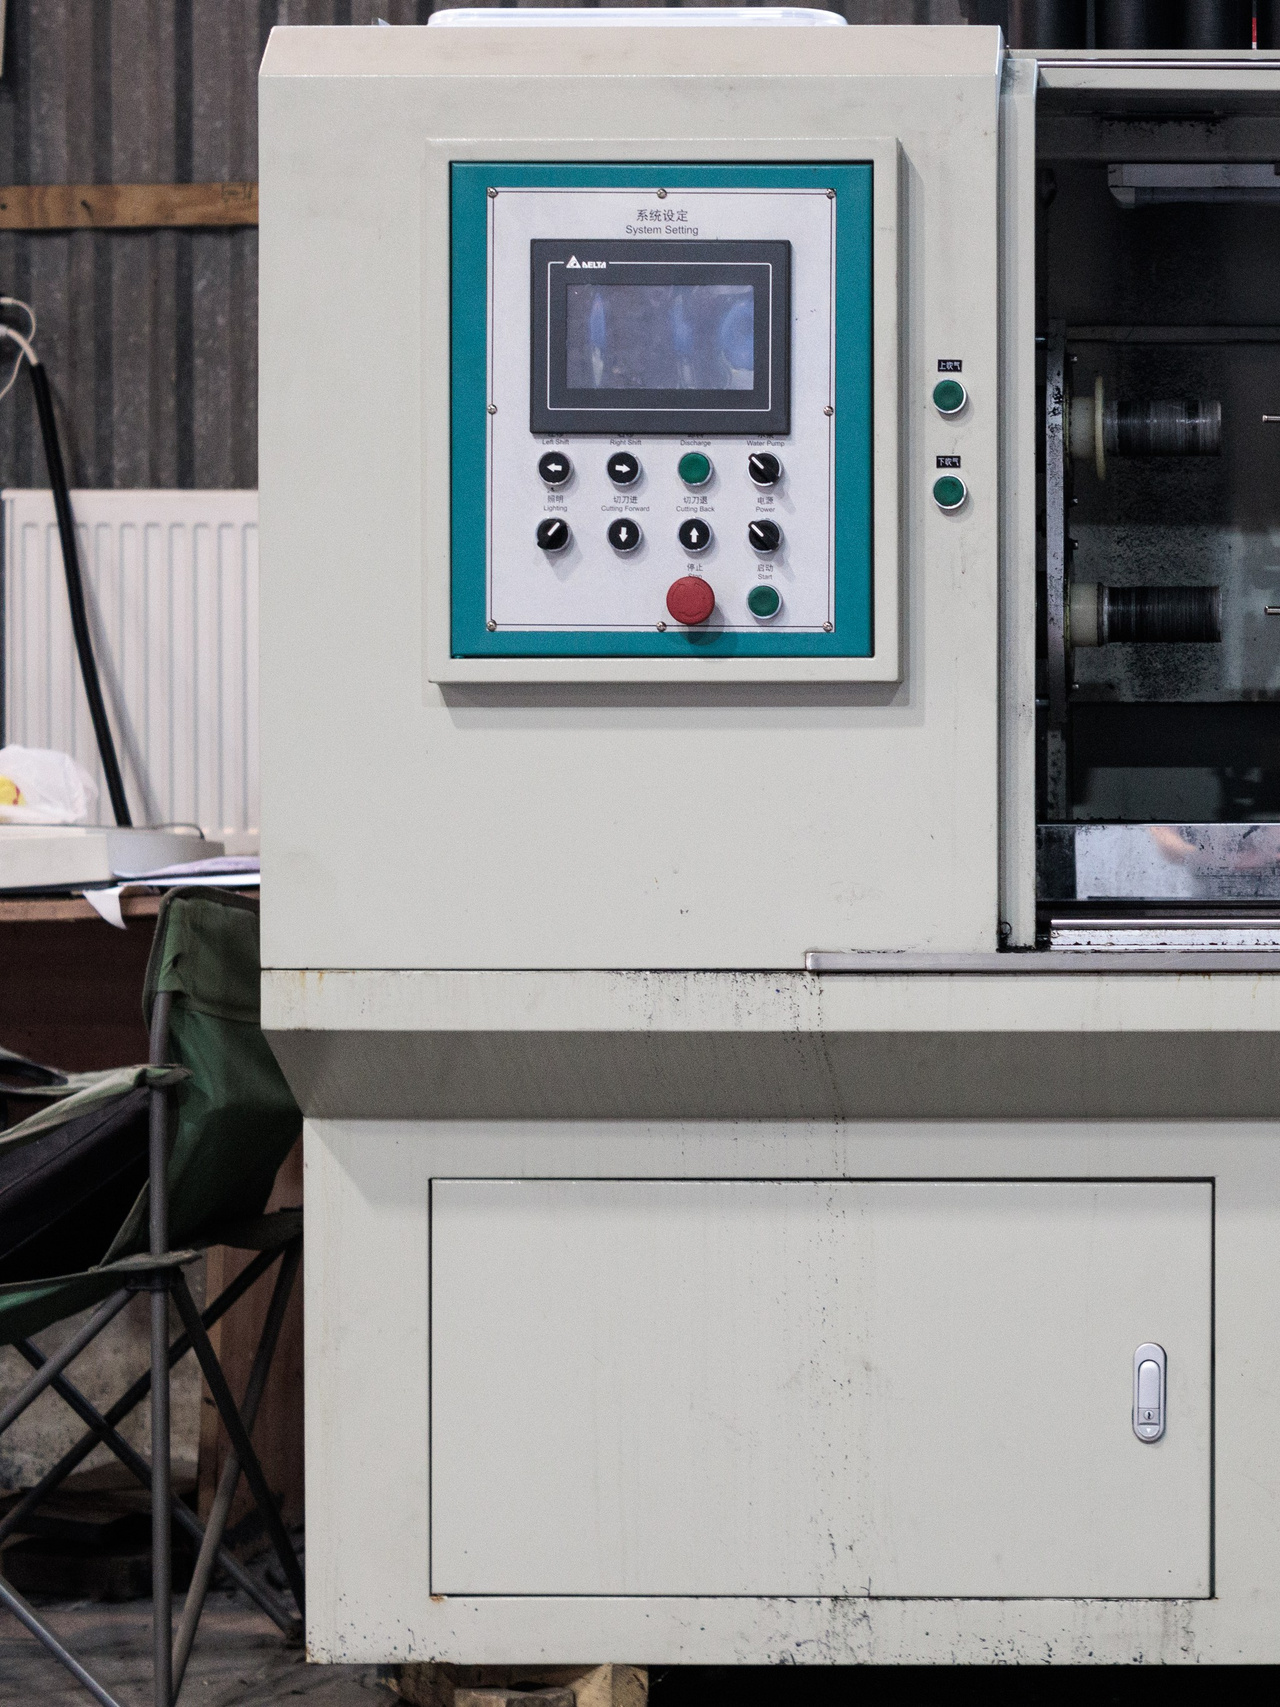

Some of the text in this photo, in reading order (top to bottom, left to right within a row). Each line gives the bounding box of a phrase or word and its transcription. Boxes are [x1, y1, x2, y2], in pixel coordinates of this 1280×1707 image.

[636, 209, 688, 222] 系统设定
[625, 225, 699, 236] System Setting
[547, 495, 564, 504] 照明
[613, 496, 638, 504] 切刀进
[683, 496, 708, 504] 切刀退
[757, 496, 774, 504] 电源
[687, 563, 704, 572] 停止
[757, 564, 774, 572] 启动
